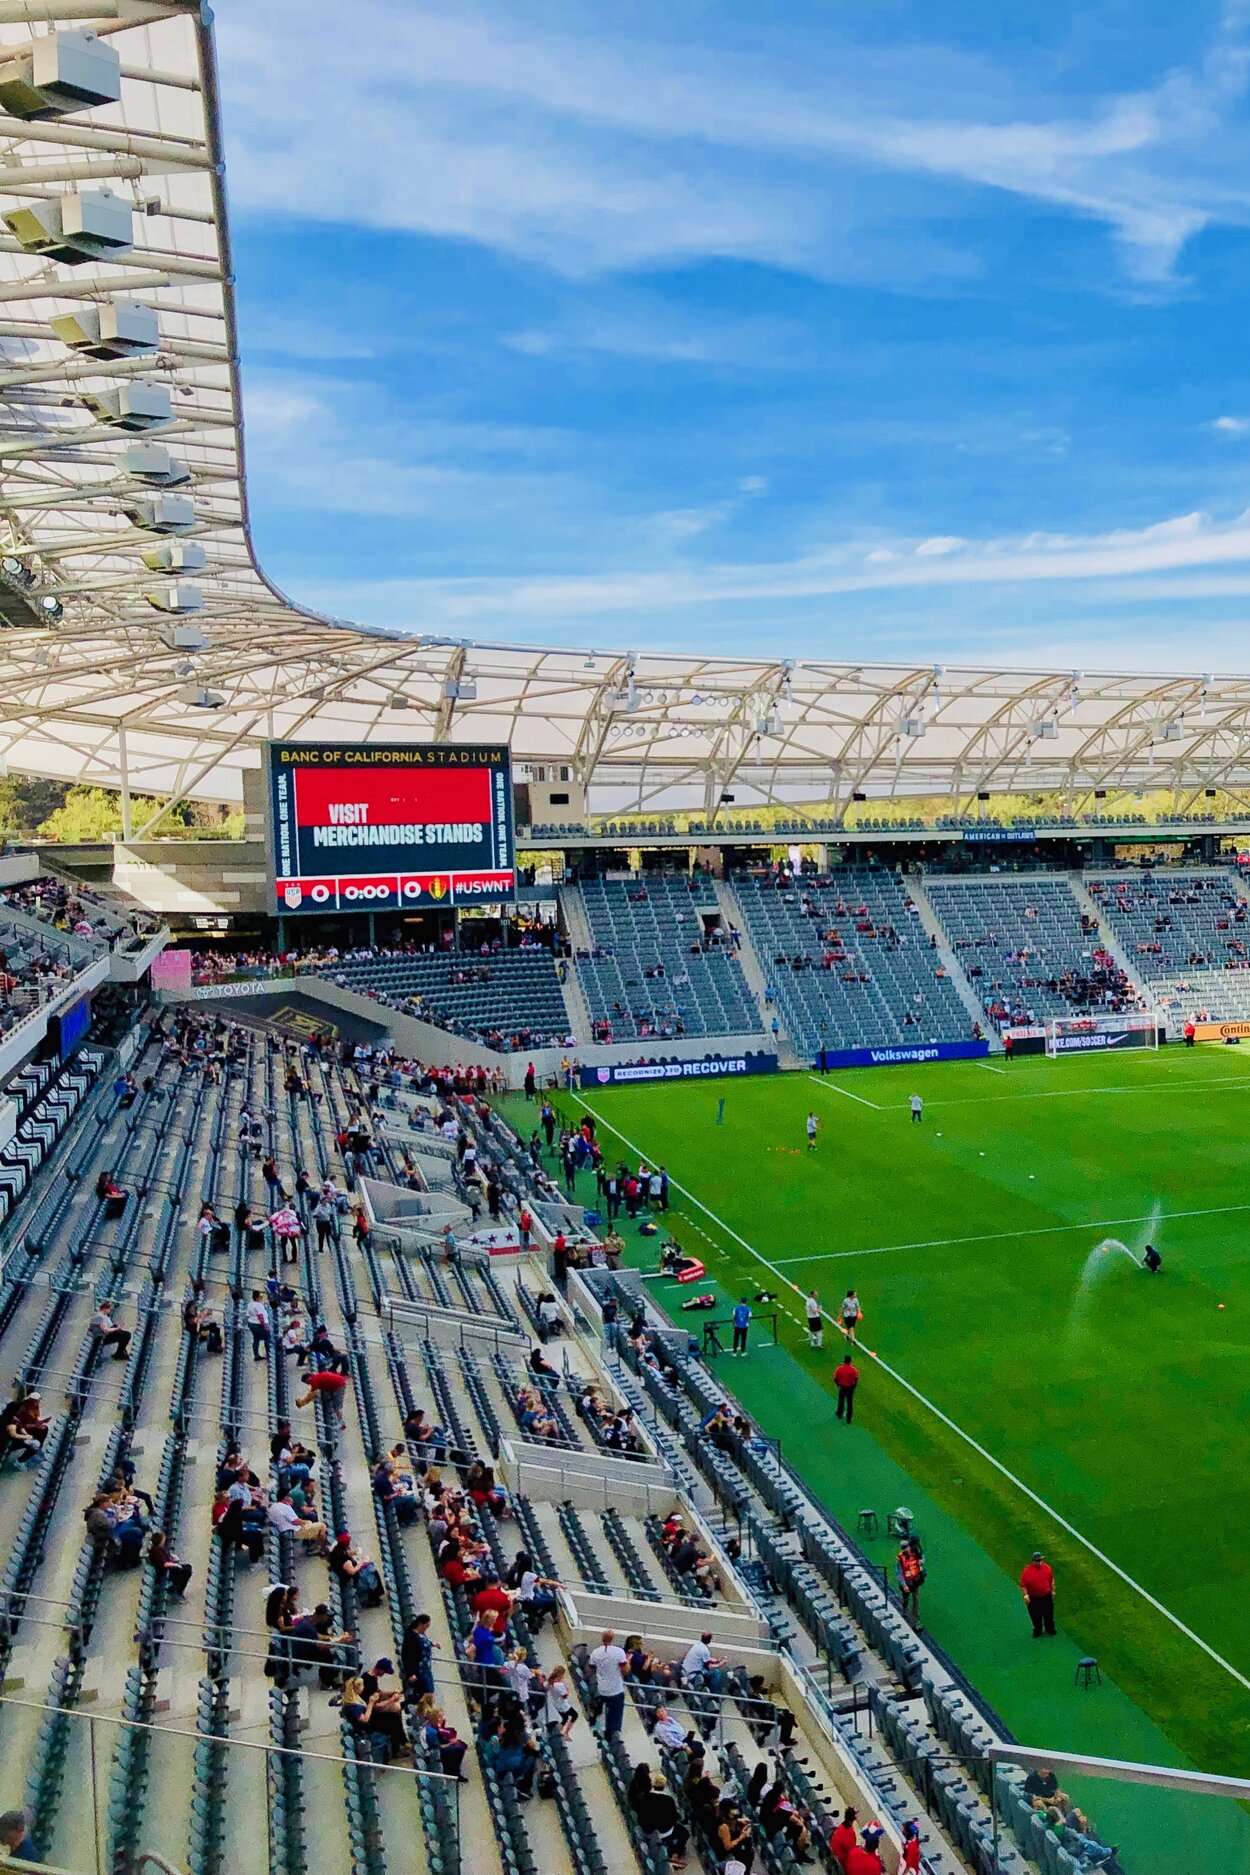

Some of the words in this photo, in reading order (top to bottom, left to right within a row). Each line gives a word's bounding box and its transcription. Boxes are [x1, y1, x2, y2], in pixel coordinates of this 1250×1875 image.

[280, 751, 319, 762] BANC
[323, 751, 341, 762] OF
[345, 751, 422, 763] CALIFORNIA
[427, 751, 501, 763] STADIUM
[328, 803, 369, 824] VISIT
[313, 825, 424, 847] MERCHANDISE
[425, 823, 483, 844] STANDS
[1006, 832, 1034, 840] OUTLAWS
[311, 885, 330, 903] 0
[345, 885, 390, 900] 0:00
[404, 881, 421, 898] 0
[455, 879, 511, 894] #USWNT
[216, 982, 265, 996] TOYOTA
[1049, 1035, 1106, 1049] NKE.COM/SOCCER
[871, 1048, 939, 1062] Volkswagen
[683, 1059, 746, 1075] RECOVER
